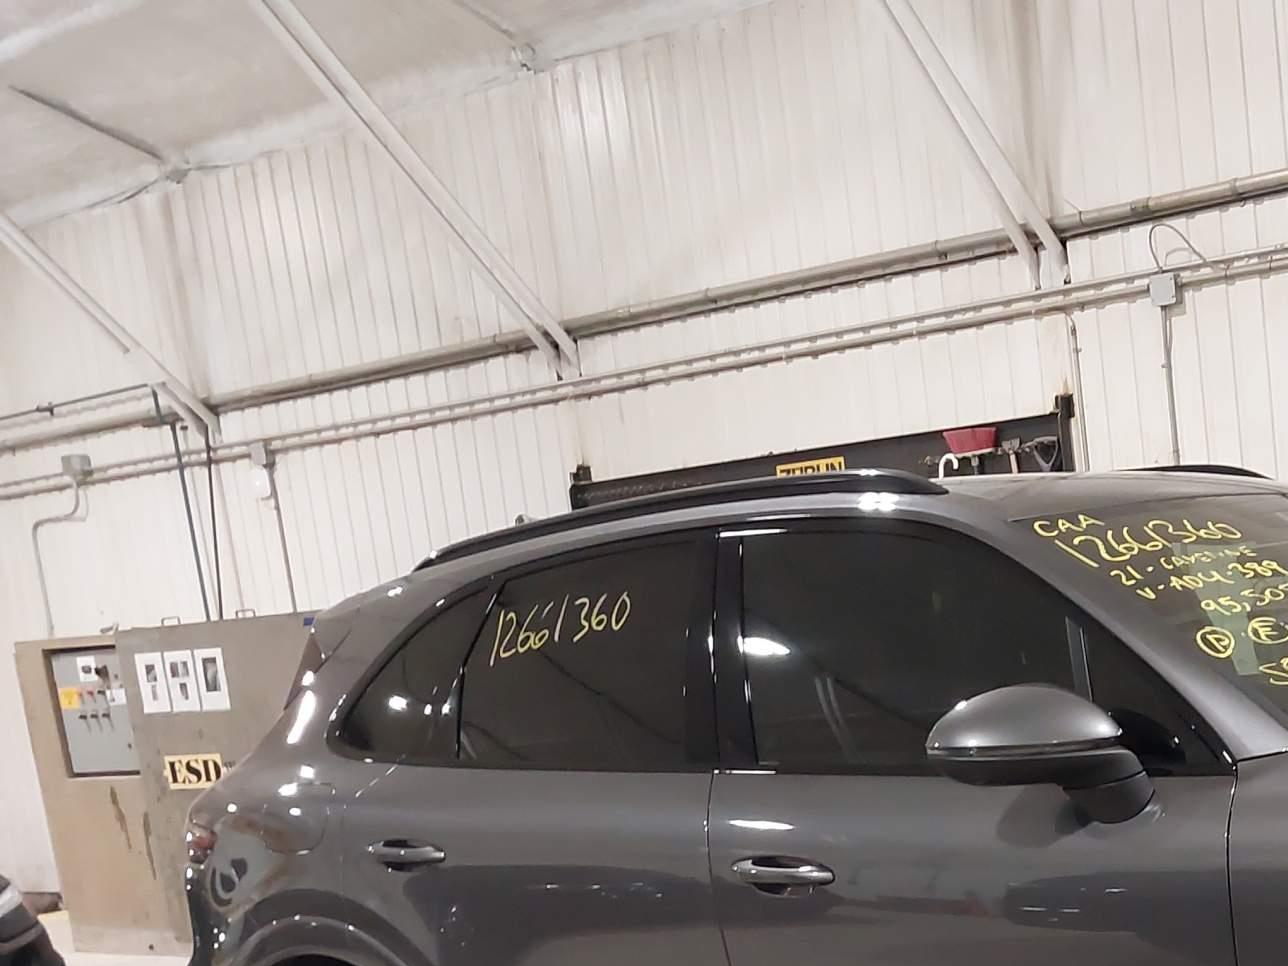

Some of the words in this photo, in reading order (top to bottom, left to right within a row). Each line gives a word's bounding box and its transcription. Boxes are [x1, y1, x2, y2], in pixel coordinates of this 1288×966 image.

[1033, 514, 1105, 537] CAA
[489, 591, 631, 667] 12661360
[168, 759, 222, 784] ESD
